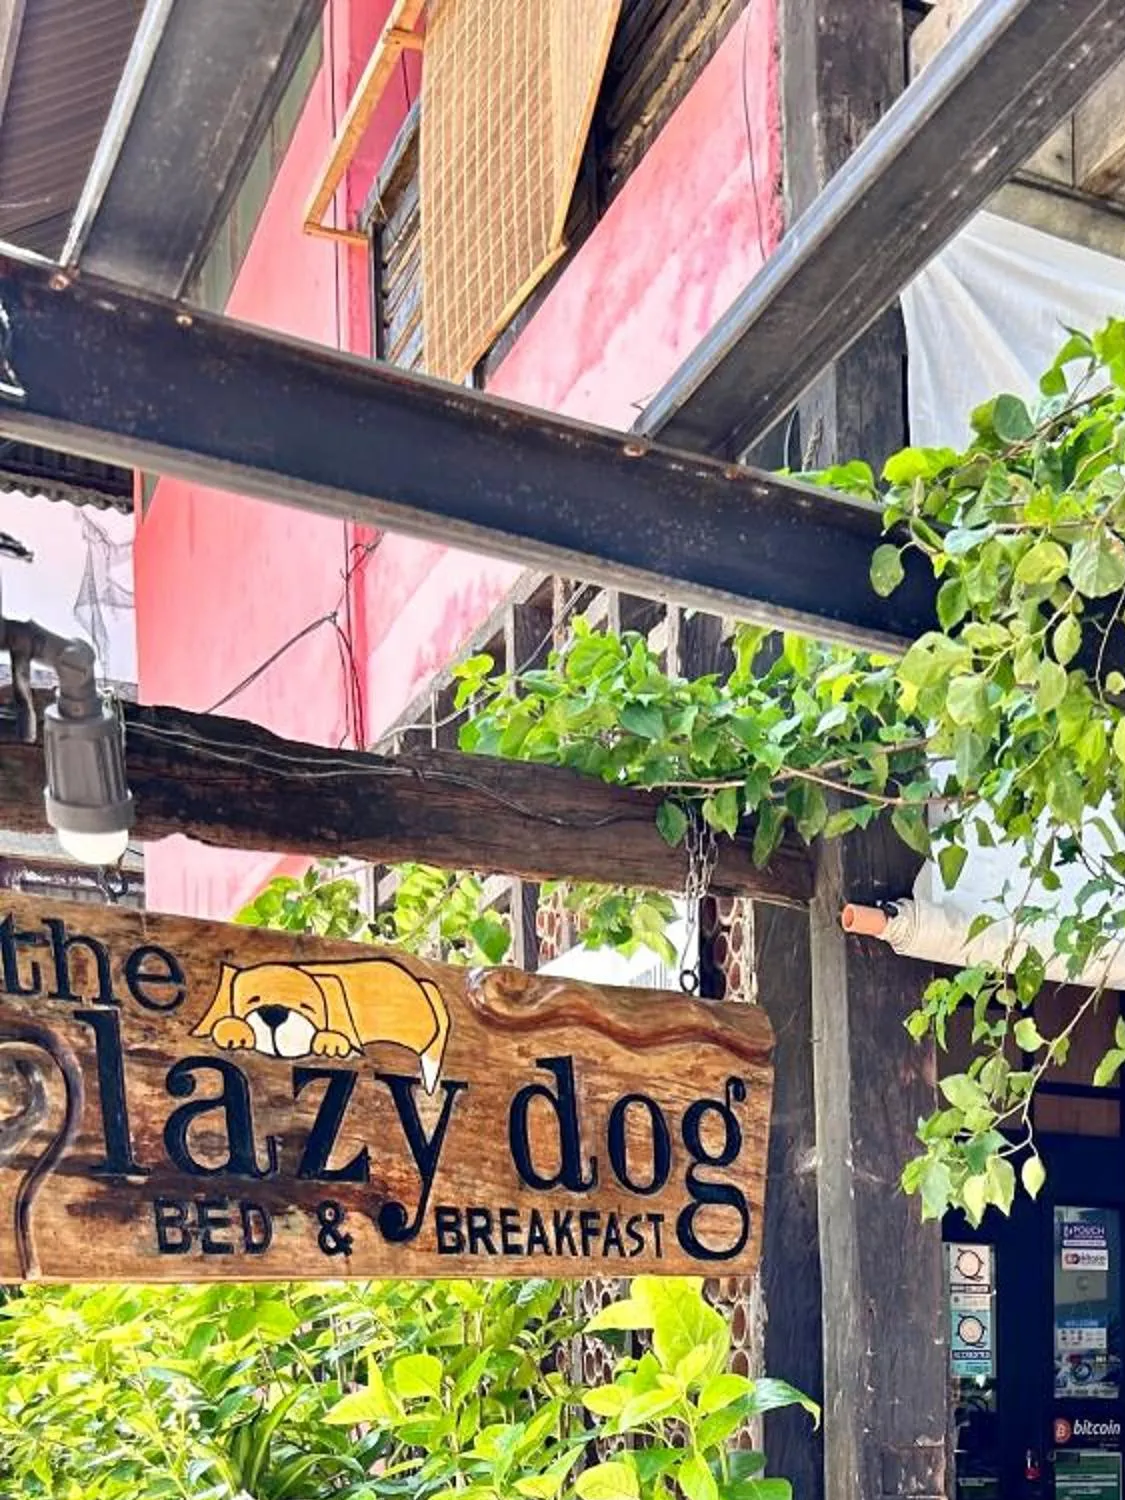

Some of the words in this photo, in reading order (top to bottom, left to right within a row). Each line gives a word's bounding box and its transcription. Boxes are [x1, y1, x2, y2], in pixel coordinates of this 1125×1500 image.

[0, 911, 188, 1011] the
[74, 1008, 468, 1243] lazy
[508, 1055, 749, 1262] dog
[155, 1197, 273, 1255] BED
[317, 1201, 353, 1257] &
[435, 1205, 665, 1258] BREAKFAST
[1073, 1419, 1121, 1435] bitcoin
